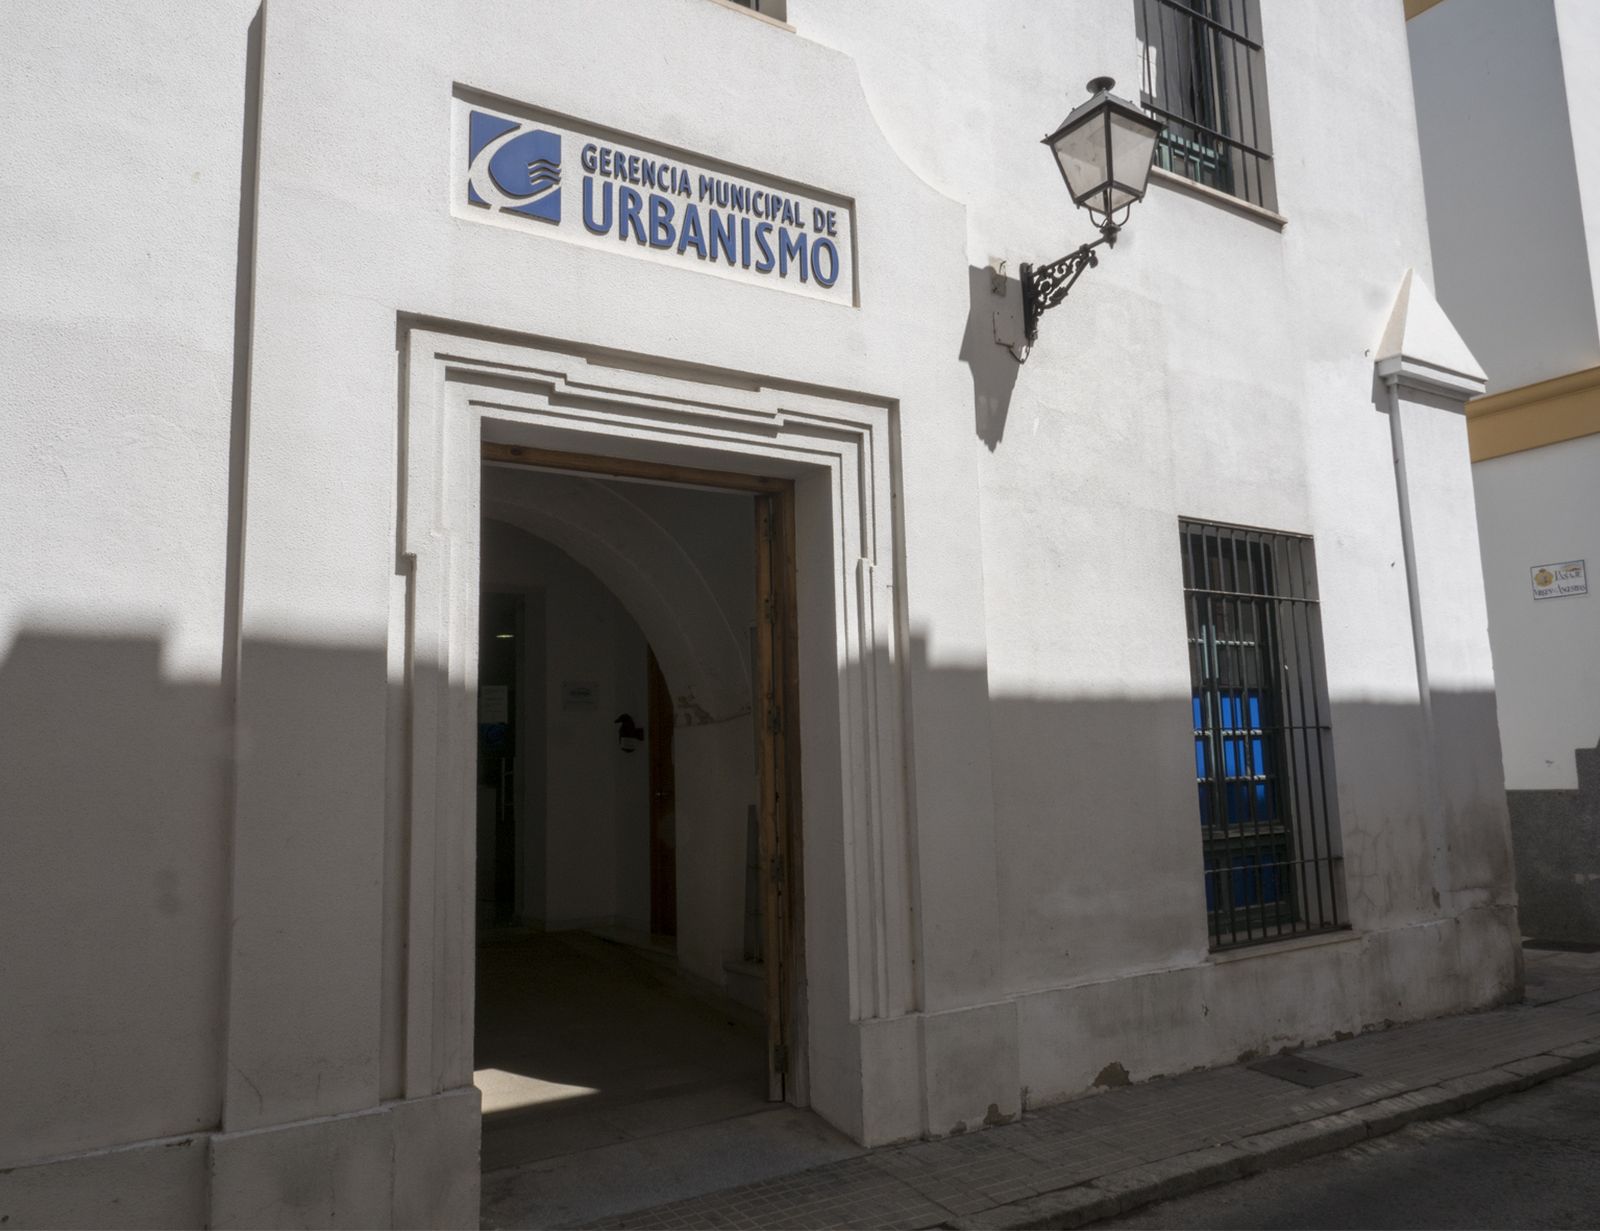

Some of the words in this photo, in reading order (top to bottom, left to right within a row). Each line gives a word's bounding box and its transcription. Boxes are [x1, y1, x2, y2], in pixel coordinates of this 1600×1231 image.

[581, 143, 692, 197] GERENCIA
[698, 175, 805, 228] MUNICIPAL
[813, 206, 838, 235] DE
[582, 176, 839, 288] URBANISMO
